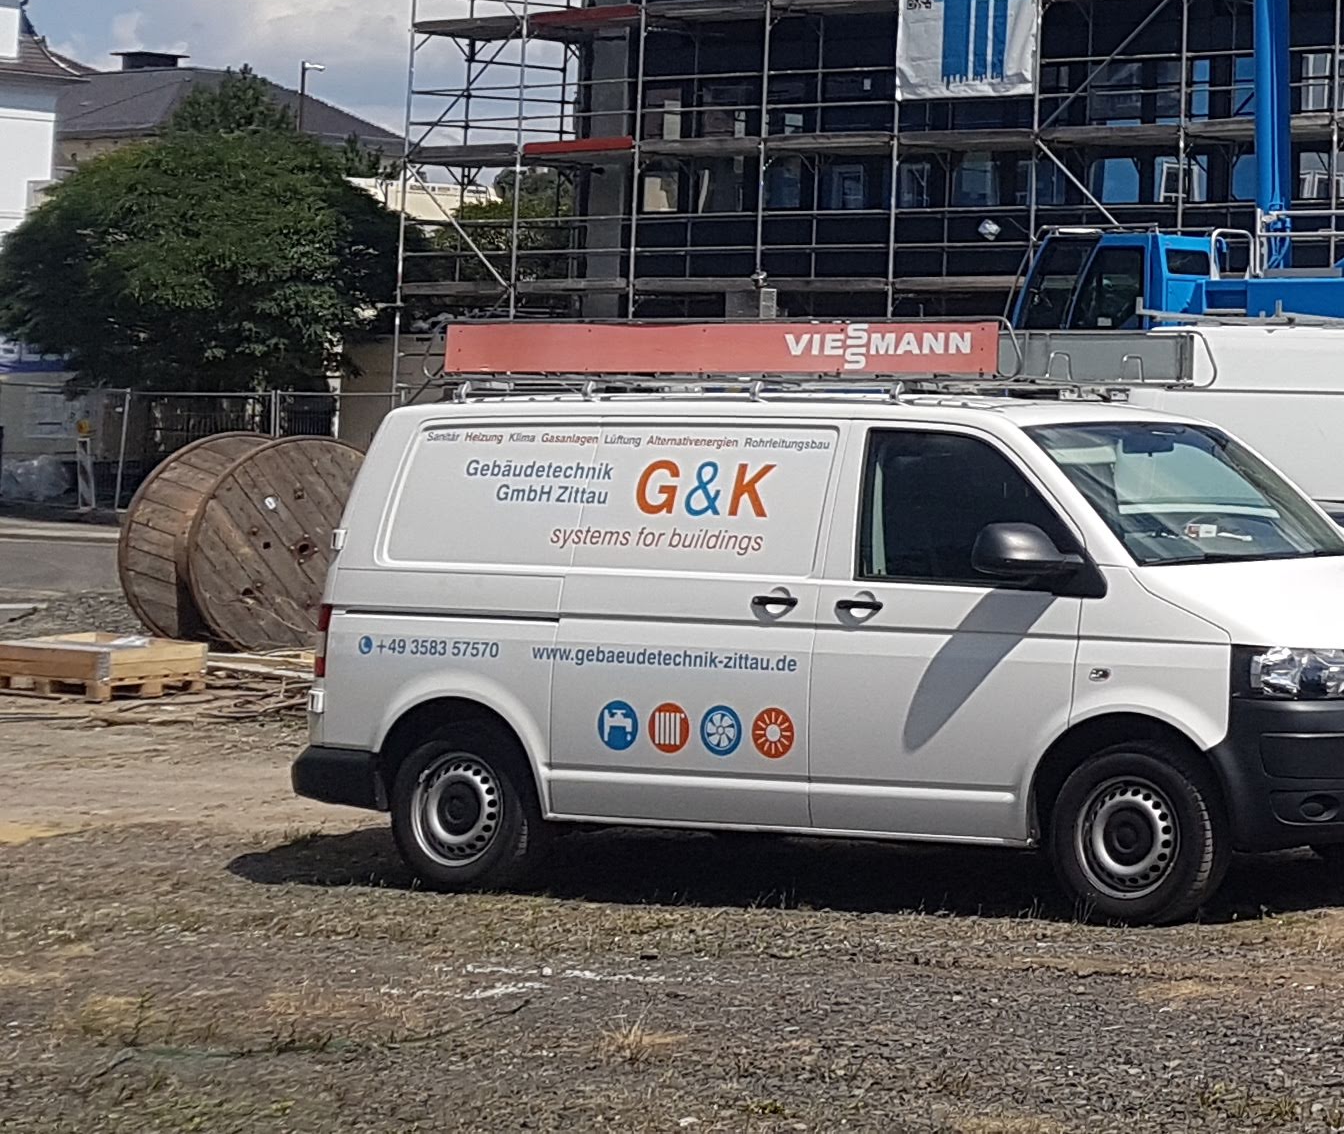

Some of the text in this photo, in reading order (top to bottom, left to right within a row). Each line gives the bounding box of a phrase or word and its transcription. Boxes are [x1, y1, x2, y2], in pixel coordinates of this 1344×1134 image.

[427, 432, 831, 451] Sanitär Heizung Klima Gasanlagen Lüftung Alternativenergien Rohrleitungsbau
[466, 459, 613, 481] Gebäudetechnik
[496, 483, 609, 505] GmbH Zittau
[635, 459, 777, 518] G&K
[550, 524, 764, 556] systems for buildings
[376, 638, 499, 658] +49 3583 57570
[532, 644, 798, 673] www.gebaeudetechnik-zittau.de
